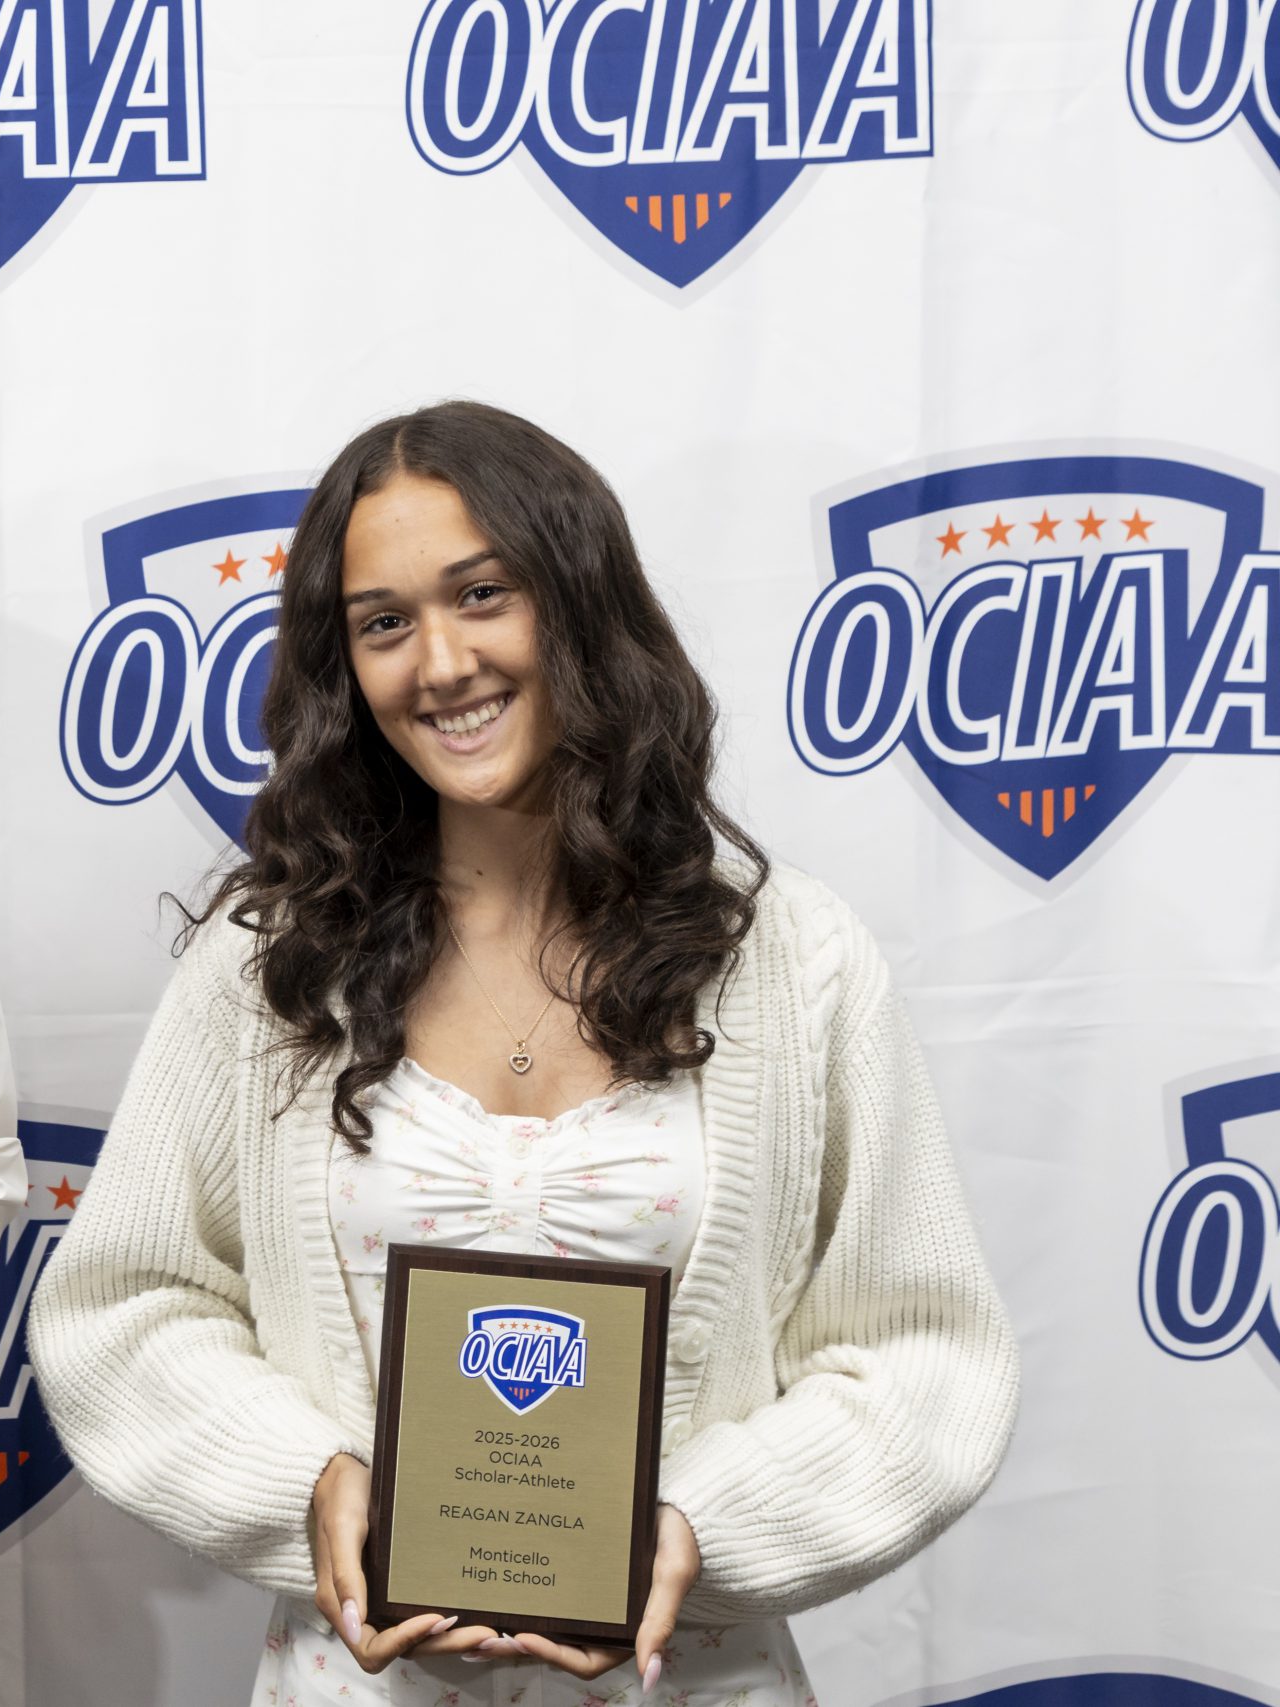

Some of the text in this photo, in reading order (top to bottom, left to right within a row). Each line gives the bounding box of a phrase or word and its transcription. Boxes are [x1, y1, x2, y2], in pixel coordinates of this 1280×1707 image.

[406, 0, 934, 175] OCIAA
[786, 548, 1280, 776] OCIAA
[459, 1329, 587, 1387] OCIAA
[475, 1430, 559, 1449] 2025-2026
[489, 1451, 542, 1467] OCIAA
[455, 1466, 575, 1489] Scholar-Athlete
[440, 1505, 584, 1529] REAGAN ZANGLA
[470, 1547, 549, 1567] Monticello
[462, 1566, 555, 1586] High School
